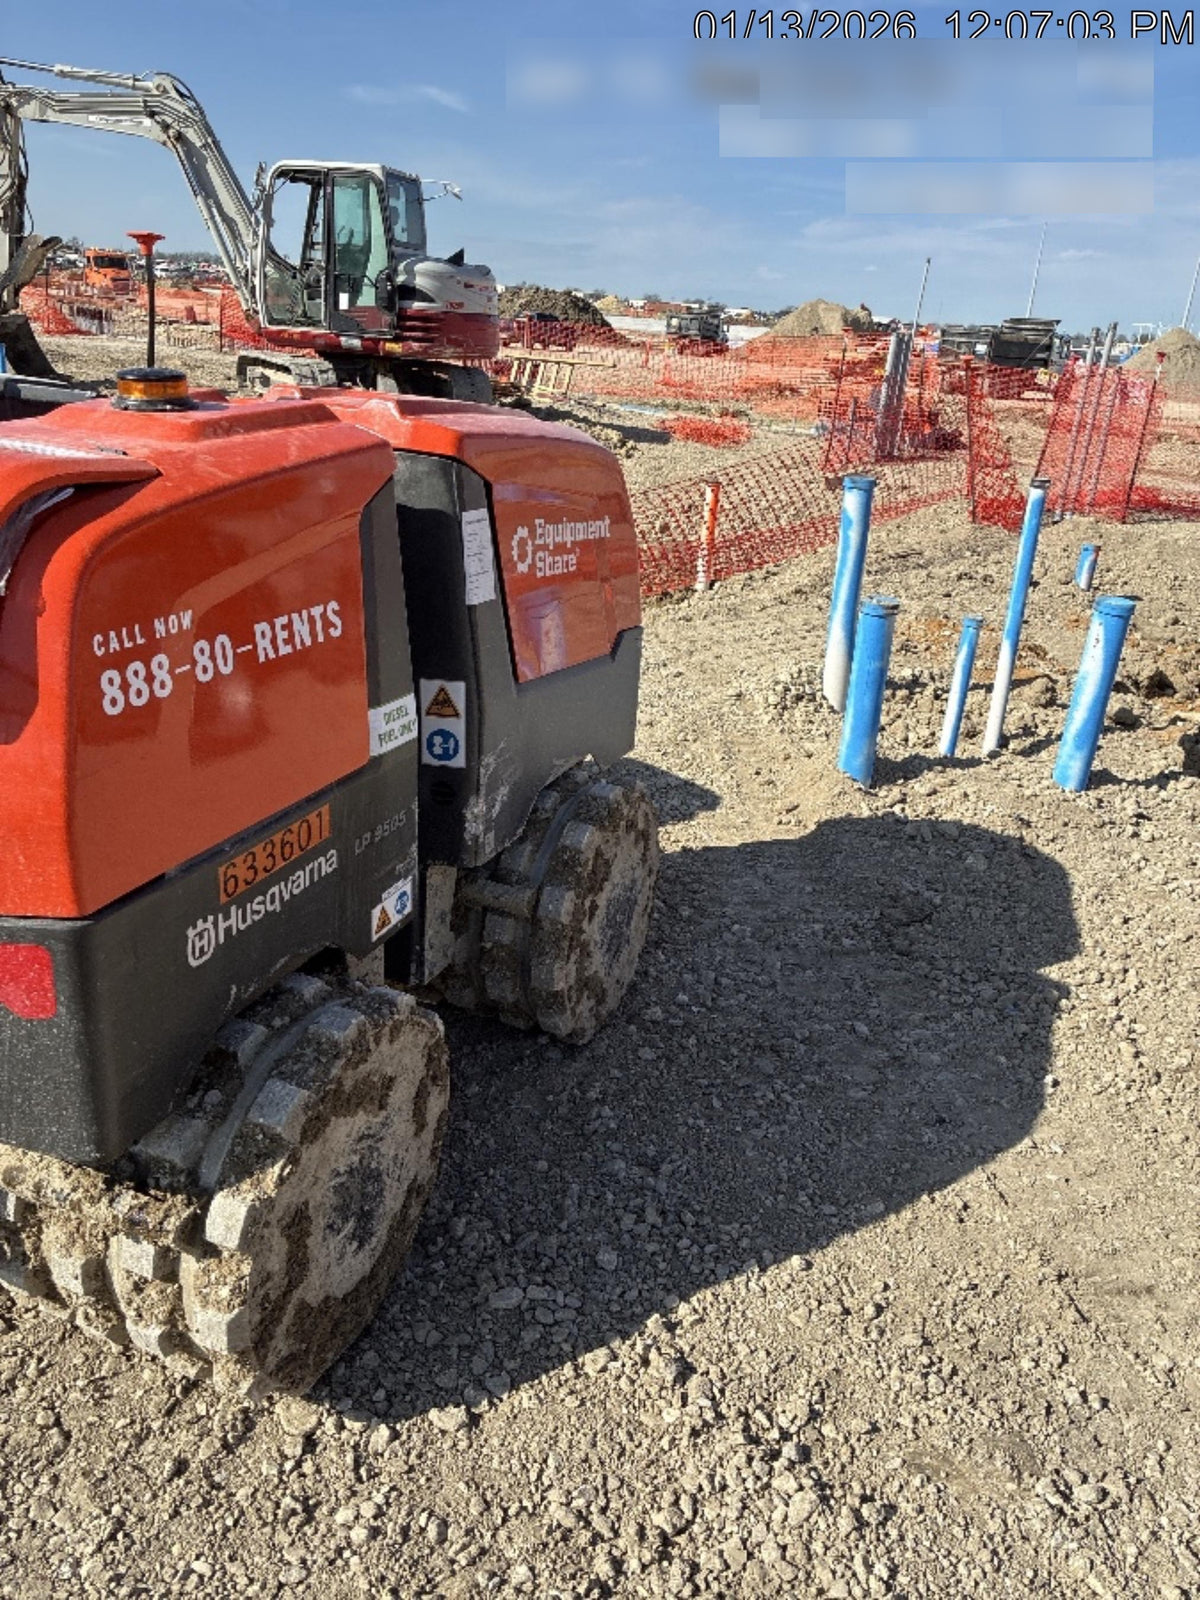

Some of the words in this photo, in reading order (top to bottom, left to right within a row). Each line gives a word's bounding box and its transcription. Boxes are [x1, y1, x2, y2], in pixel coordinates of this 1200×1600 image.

[534, 515, 611, 550] Equipment
[535, 550, 577, 578] Share
[93, 623, 146, 656] CALL
[154, 609, 193, 639] NOW
[222, 810, 325, 899] 633601
[217, 848, 339, 945] Husqvarna
